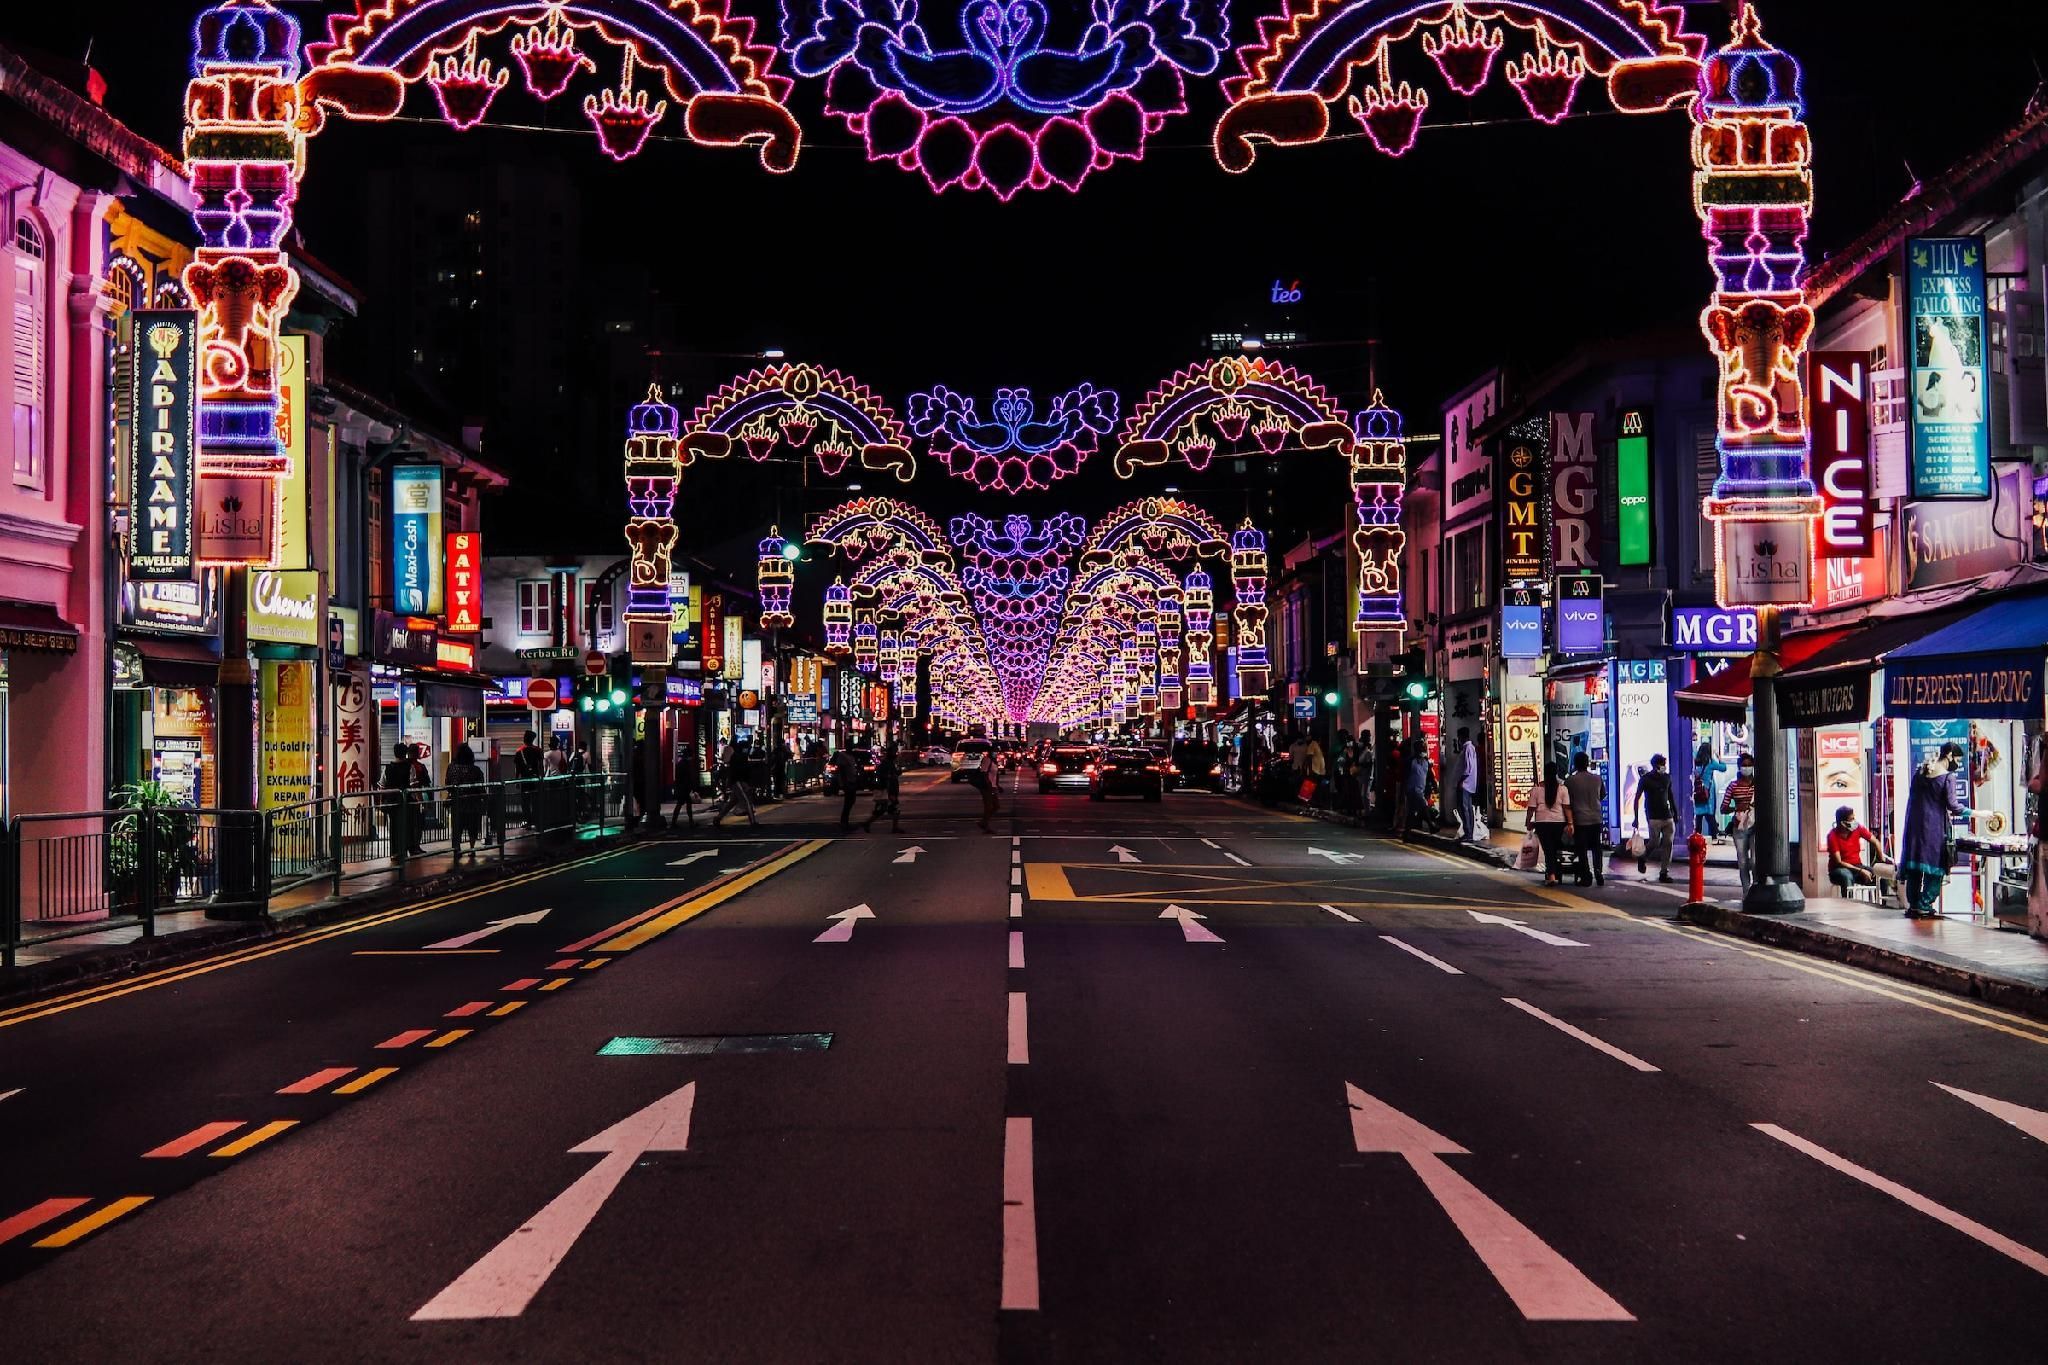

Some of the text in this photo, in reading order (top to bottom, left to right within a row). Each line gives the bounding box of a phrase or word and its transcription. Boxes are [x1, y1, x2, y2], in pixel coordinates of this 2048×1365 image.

[1931, 244, 1961, 275] LILY
[1821, 362, 1864, 545] NICE
[1554, 412, 1598, 567] MGR
[1508, 472, 1538, 556] GMT
[131, 556, 190, 567] JEWELLERS
[404, 519, 418, 588] Maxi-Cash
[455, 535, 471, 623] SATYA
[1736, 554, 1799, 579] Lisha
[255, 571, 316, 620] Chennai
[1506, 619, 1539, 630] vivo
[1565, 611, 1598, 621] vivo
[1676, 613, 1758, 645] MGR
[520, 647, 574, 659] Kerbau Rd
[1620, 693, 1650, 705] OPPO
[1821, 684, 1855, 713] MOTORS
[1891, 670, 2032, 705] LILY EXPRESS TAILORING
[280, 740, 300, 752] Gold
[1555, 728, 1571, 742] 5G
[1821, 736, 1860, 750] NICE
[266, 775, 312, 787] EXCHANGE
[274, 791, 306, 802] REPAIR
